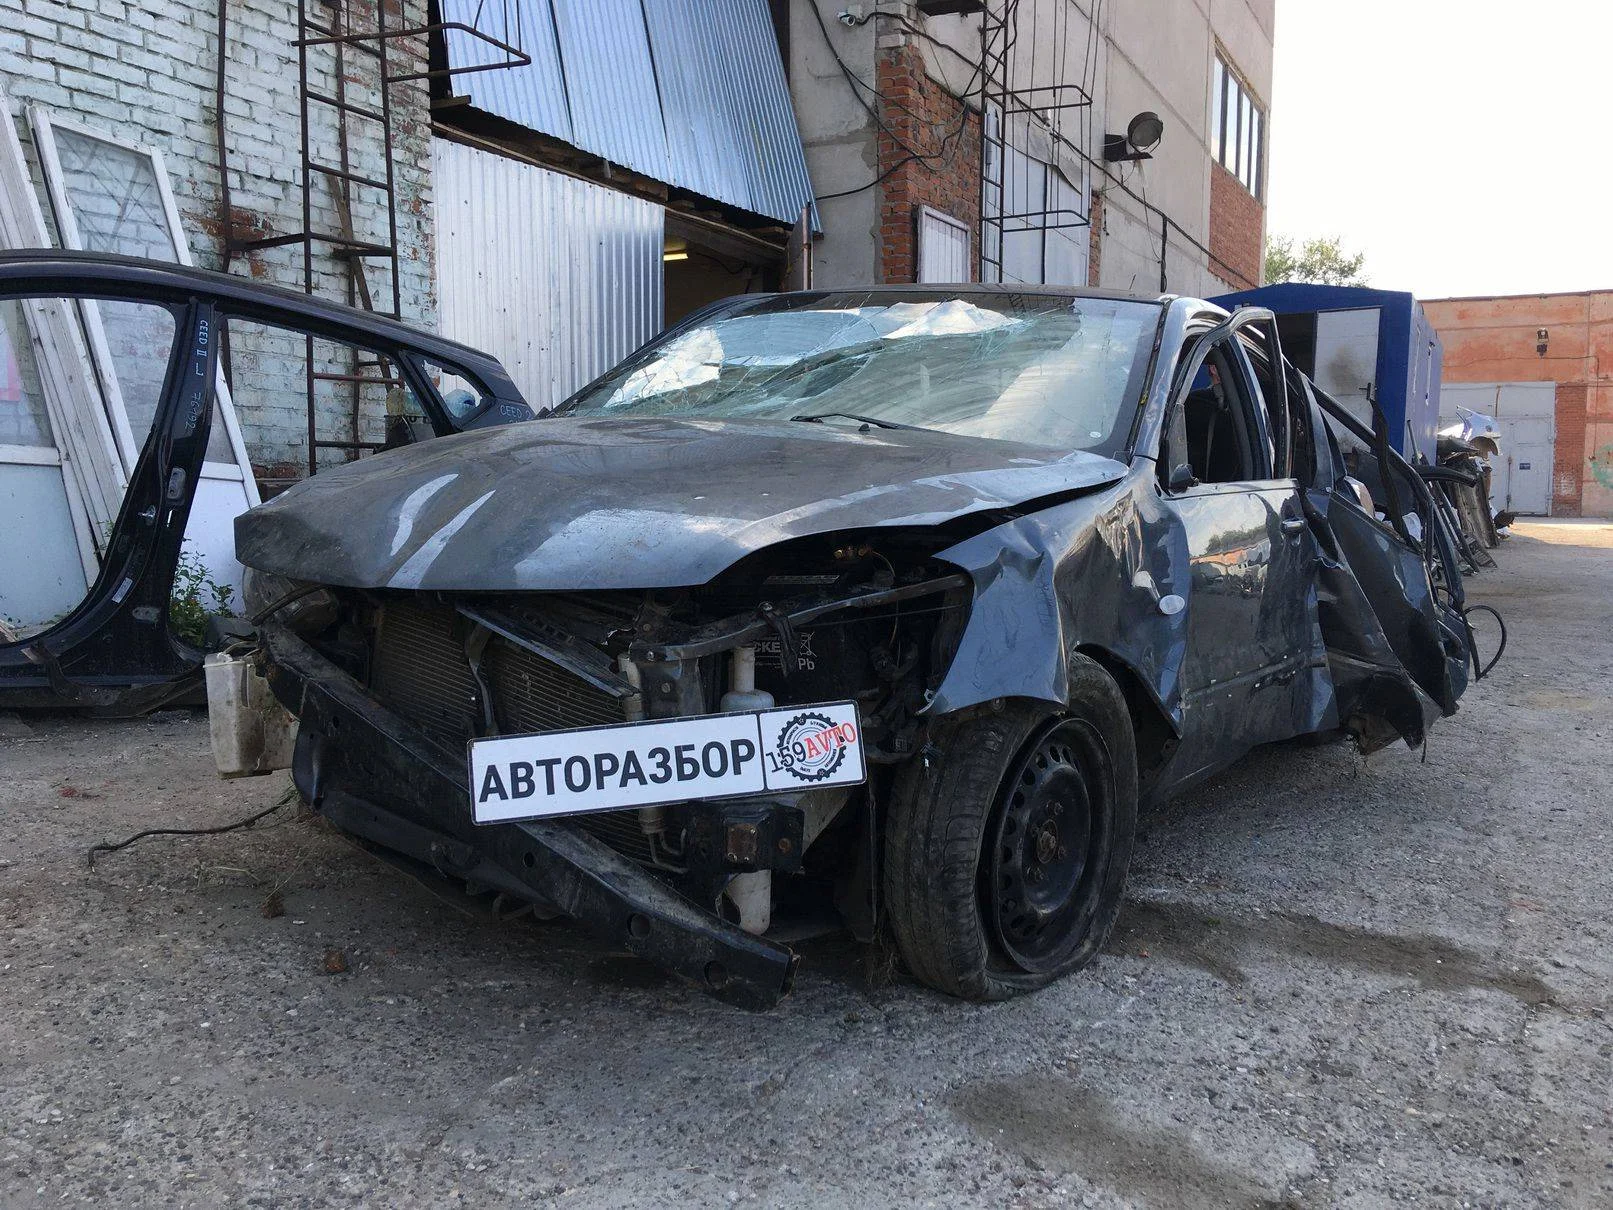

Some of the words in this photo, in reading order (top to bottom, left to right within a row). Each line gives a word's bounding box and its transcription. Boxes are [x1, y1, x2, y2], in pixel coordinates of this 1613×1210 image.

[198, 319, 209, 345] CEED
[797, 657, 816, 671] Pb
[478, 738, 756, 803] АВТОРАЗБОР
